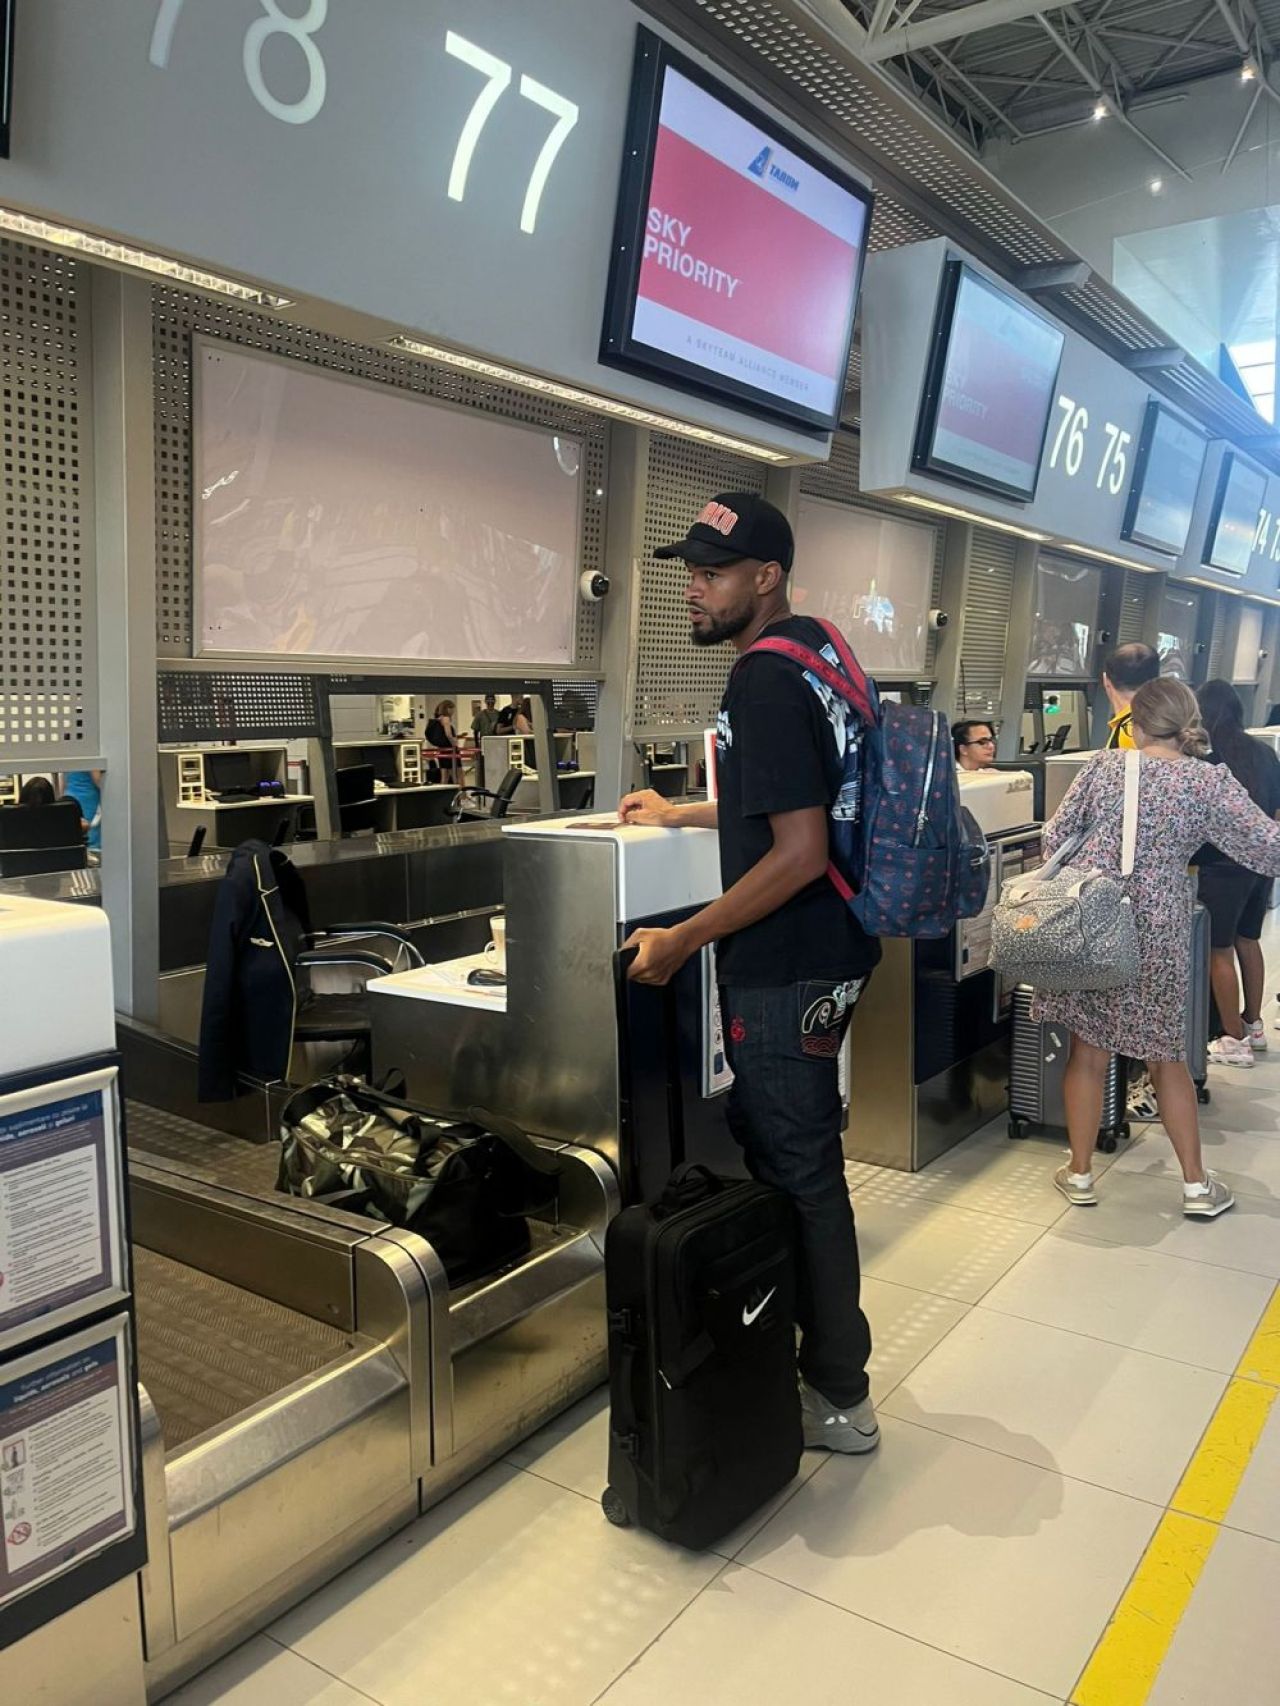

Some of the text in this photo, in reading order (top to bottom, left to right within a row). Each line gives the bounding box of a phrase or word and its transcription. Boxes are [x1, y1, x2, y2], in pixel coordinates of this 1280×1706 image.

[445, 30, 579, 235] 77
[768, 163, 800, 192] TAROM
[648, 207, 692, 247] SKY
[643, 234, 739, 298] PRIORITY
[1050, 396, 1089, 476] 76
[1097, 423, 1131, 494] 75
